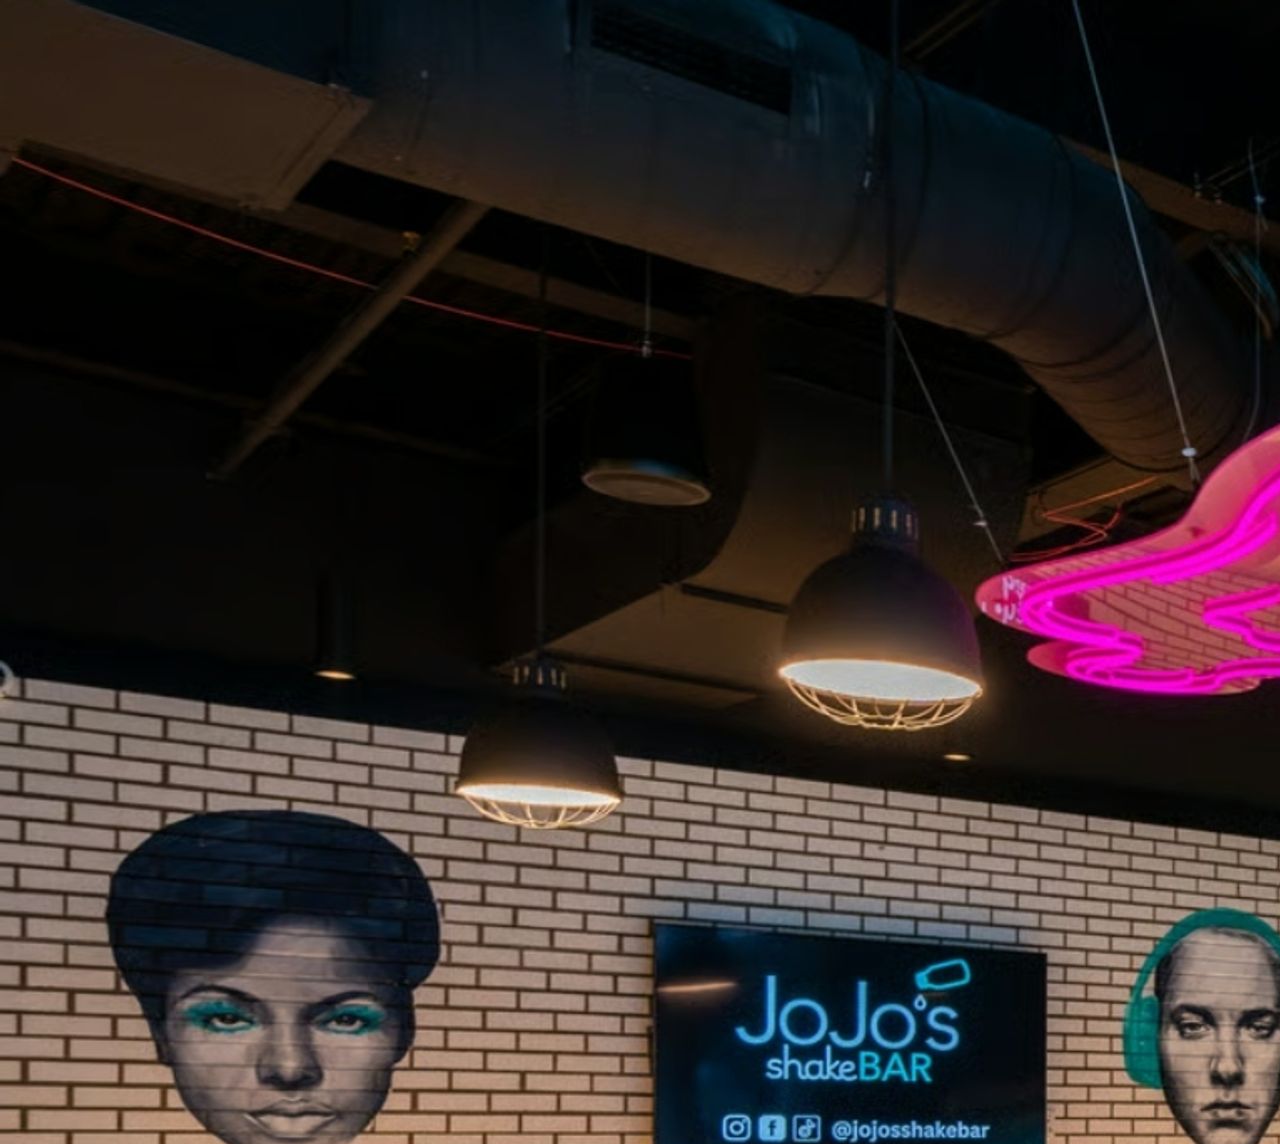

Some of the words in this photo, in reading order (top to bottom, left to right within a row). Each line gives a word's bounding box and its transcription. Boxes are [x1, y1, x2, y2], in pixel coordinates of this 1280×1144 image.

[735, 974, 960, 1052] JoJo's
[766, 1044, 933, 1085] shakeBAR
[831, 1119, 991, 1143] @jojosshakebar
